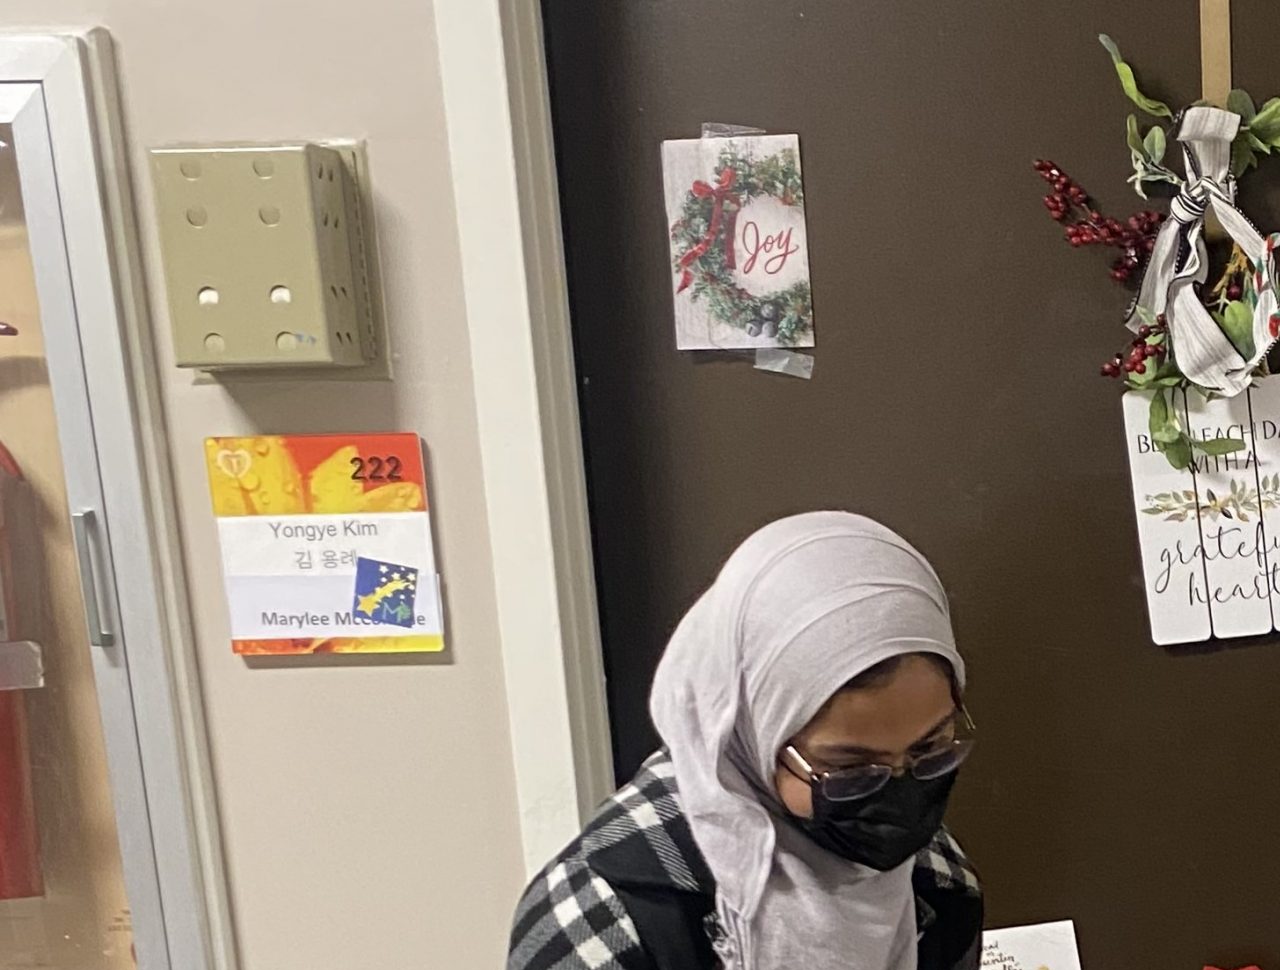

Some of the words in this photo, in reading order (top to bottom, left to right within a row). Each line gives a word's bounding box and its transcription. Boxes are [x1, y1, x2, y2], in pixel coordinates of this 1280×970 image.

[742, 221, 799, 275] Joy
[350, 456, 402, 480] 222
[1243, 450, 1262, 469] A
[269, 521, 337, 541] Yongye
[343, 520, 378, 537] Kim
[294, 550, 313, 569] 김
[261, 612, 329, 629] Marylee
